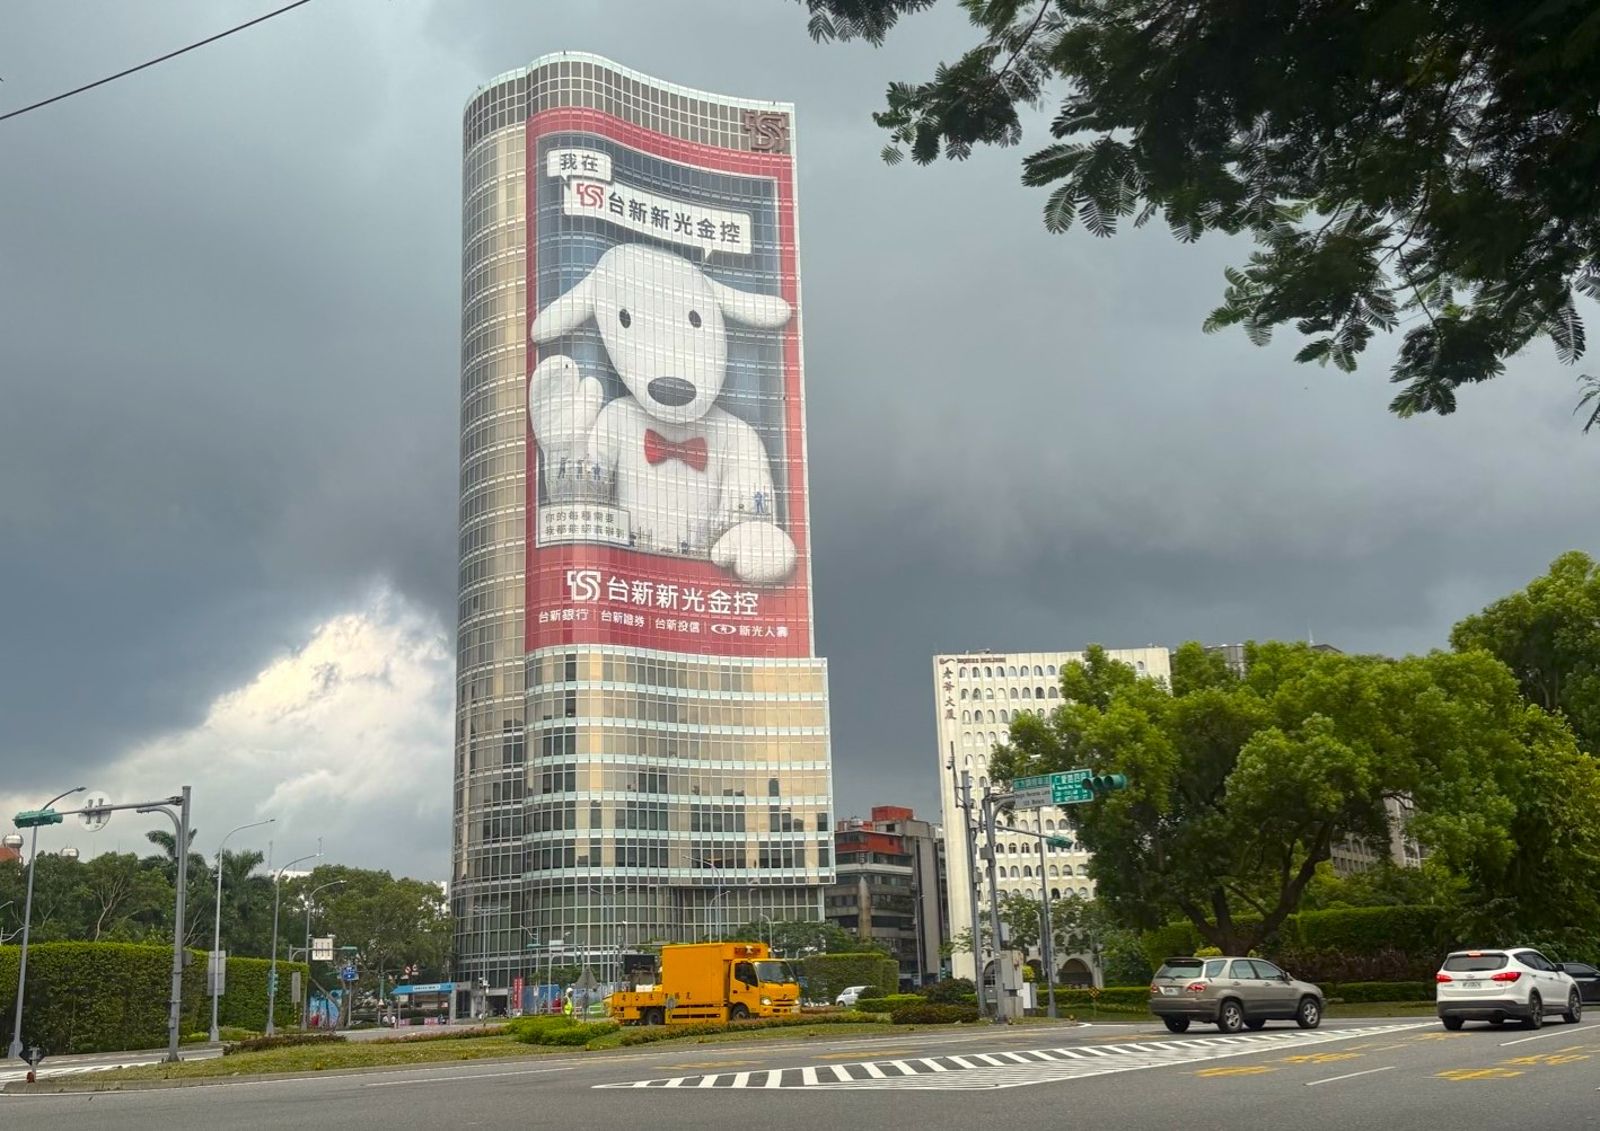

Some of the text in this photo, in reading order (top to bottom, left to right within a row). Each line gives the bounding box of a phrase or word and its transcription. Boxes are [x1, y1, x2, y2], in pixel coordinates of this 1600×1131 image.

[560, 153, 599, 171] 我在
[608, 191, 741, 244] 台新新光金控
[606, 575, 759, 616] 台新新光金控
[538, 608, 589, 624] 台新銀行
[600, 610, 645, 627] 台新證券
[655, 617, 700, 633] 台新投信
